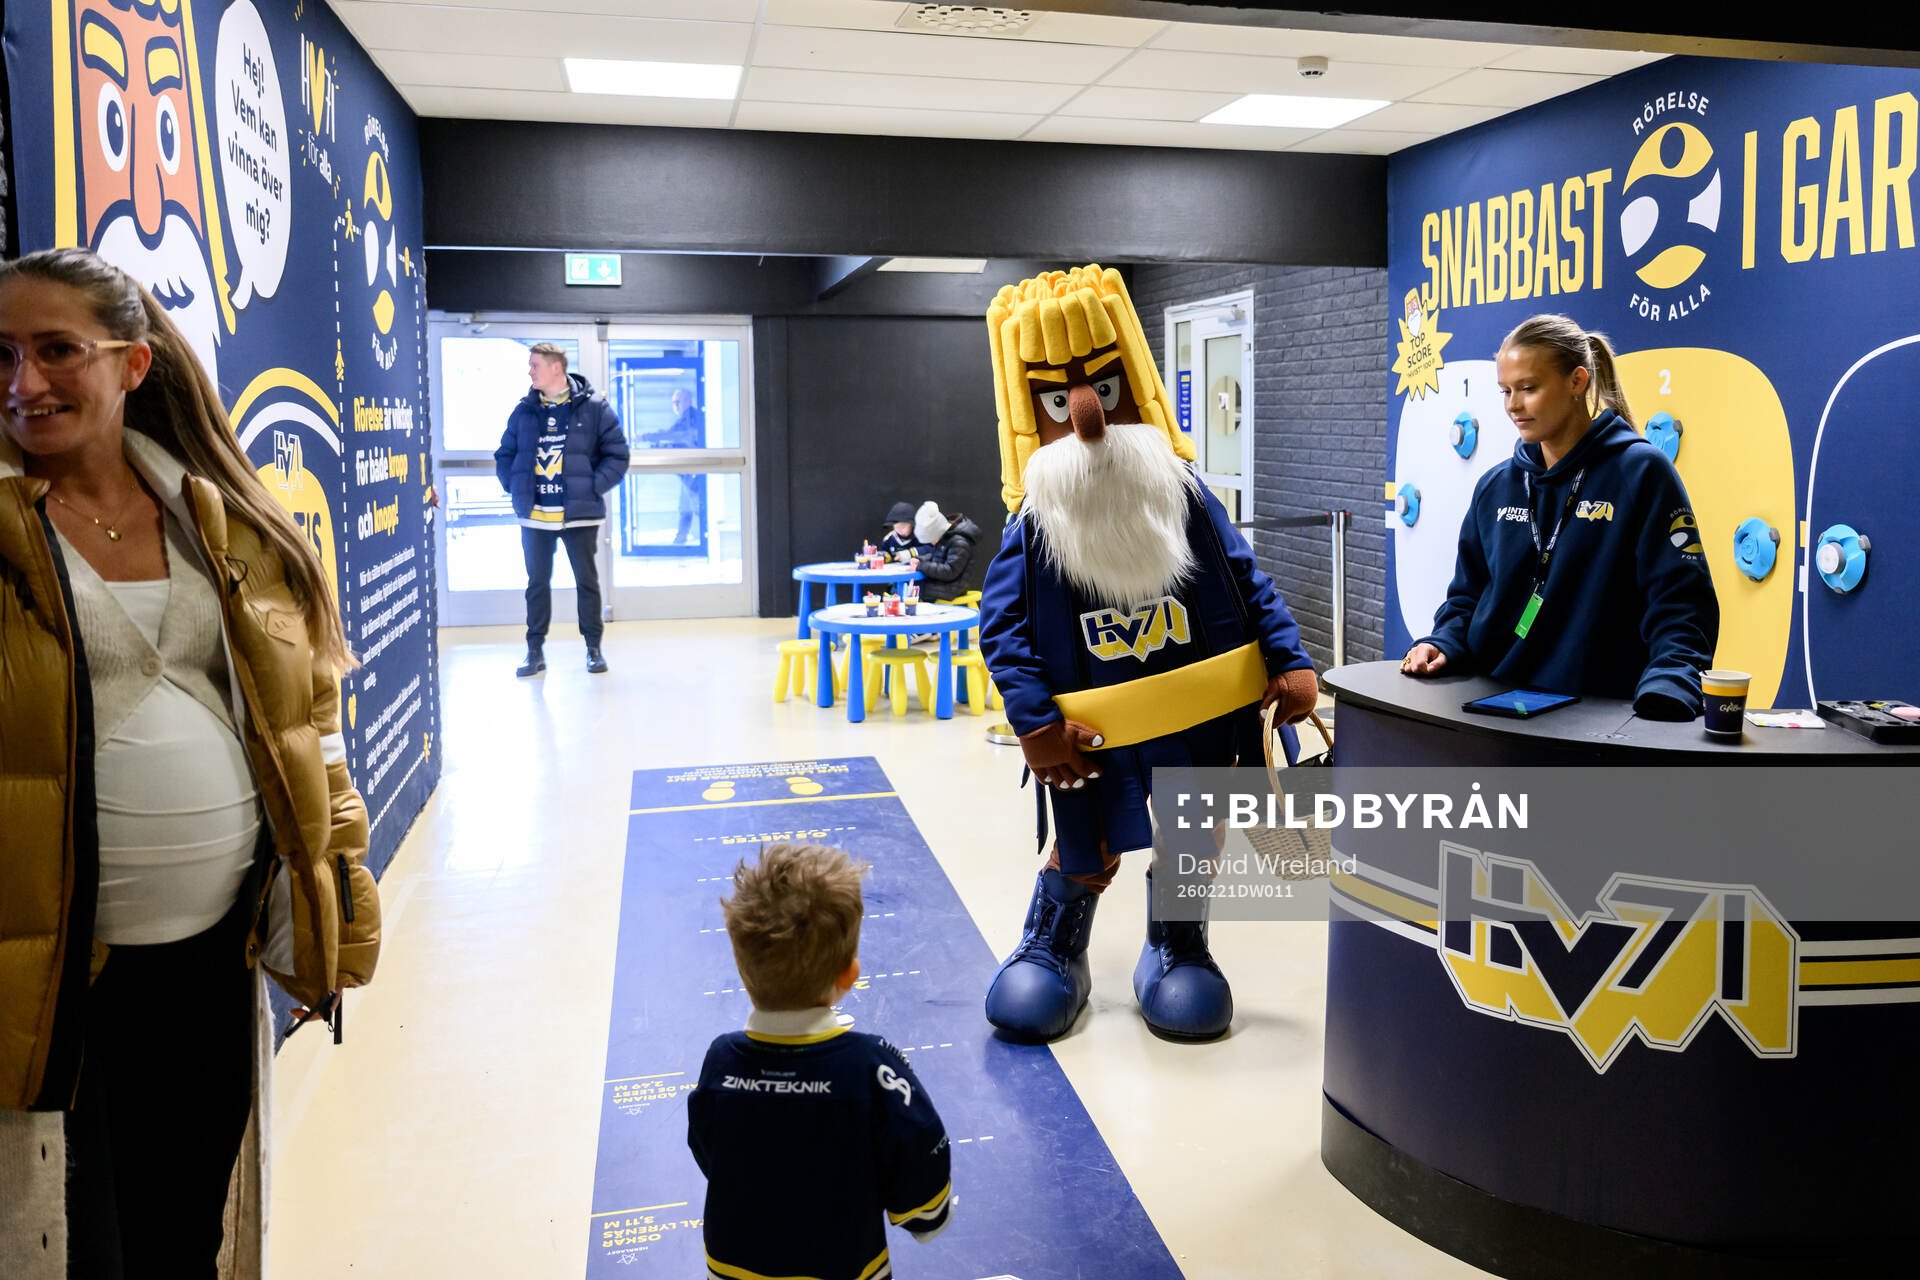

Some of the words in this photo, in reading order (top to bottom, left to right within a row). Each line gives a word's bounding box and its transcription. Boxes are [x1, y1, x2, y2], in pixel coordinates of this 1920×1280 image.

[242, 42, 265, 99] Hej!
[231, 79, 257, 134] Vem
[259, 106, 277, 152] kan
[1632, 90, 1710, 136] RÖRELSE
[228, 131, 260, 185] vinna
[261, 155, 283, 203] över
[308, 131, 319, 167] för
[319, 148, 332, 185] alla
[1742, 130, 1758, 270] I
[1780, 91, 1919, 265] GAR
[245, 198, 271, 246] mig?
[1421, 168, 1612, 312] SNABBAST
[1629, 293, 1660, 322] FÖR
[1668, 284, 1711, 322] ALLA
[1407, 343, 1432, 369] SCORE
[1410, 332, 1426, 351] TOP
[1463, 378, 1469, 397] 1
[1658, 369, 1672, 396] 2
[354, 395, 384, 432] Rörelse
[383, 397, 392, 431] är
[392, 397, 414, 438] viktigt
[273, 430, 304, 499] HV71
[355, 449, 369, 486] för
[369, 447, 389, 483] både
[388, 447, 408, 484] kropp
[357, 502, 374, 541] och
[373, 495, 399, 536] knopp!
[1575, 500, 1614, 522] HV71
[1080, 595, 1191, 662] HV71
[722, 834, 791, 845] METER
[1437, 839, 1800, 1075] HV71
[613, 1089, 654, 1097] LEEST
[613, 1092, 677, 1104] ADRIANA
[631, 1081, 664, 1089] 2,49
[722, 1075, 831, 1093] ZINKTEKNIK
[603, 1220, 620, 1230] M
[625, 1215, 655, 1227] 3,11
[602, 1233, 662, 1248] OSKAR
